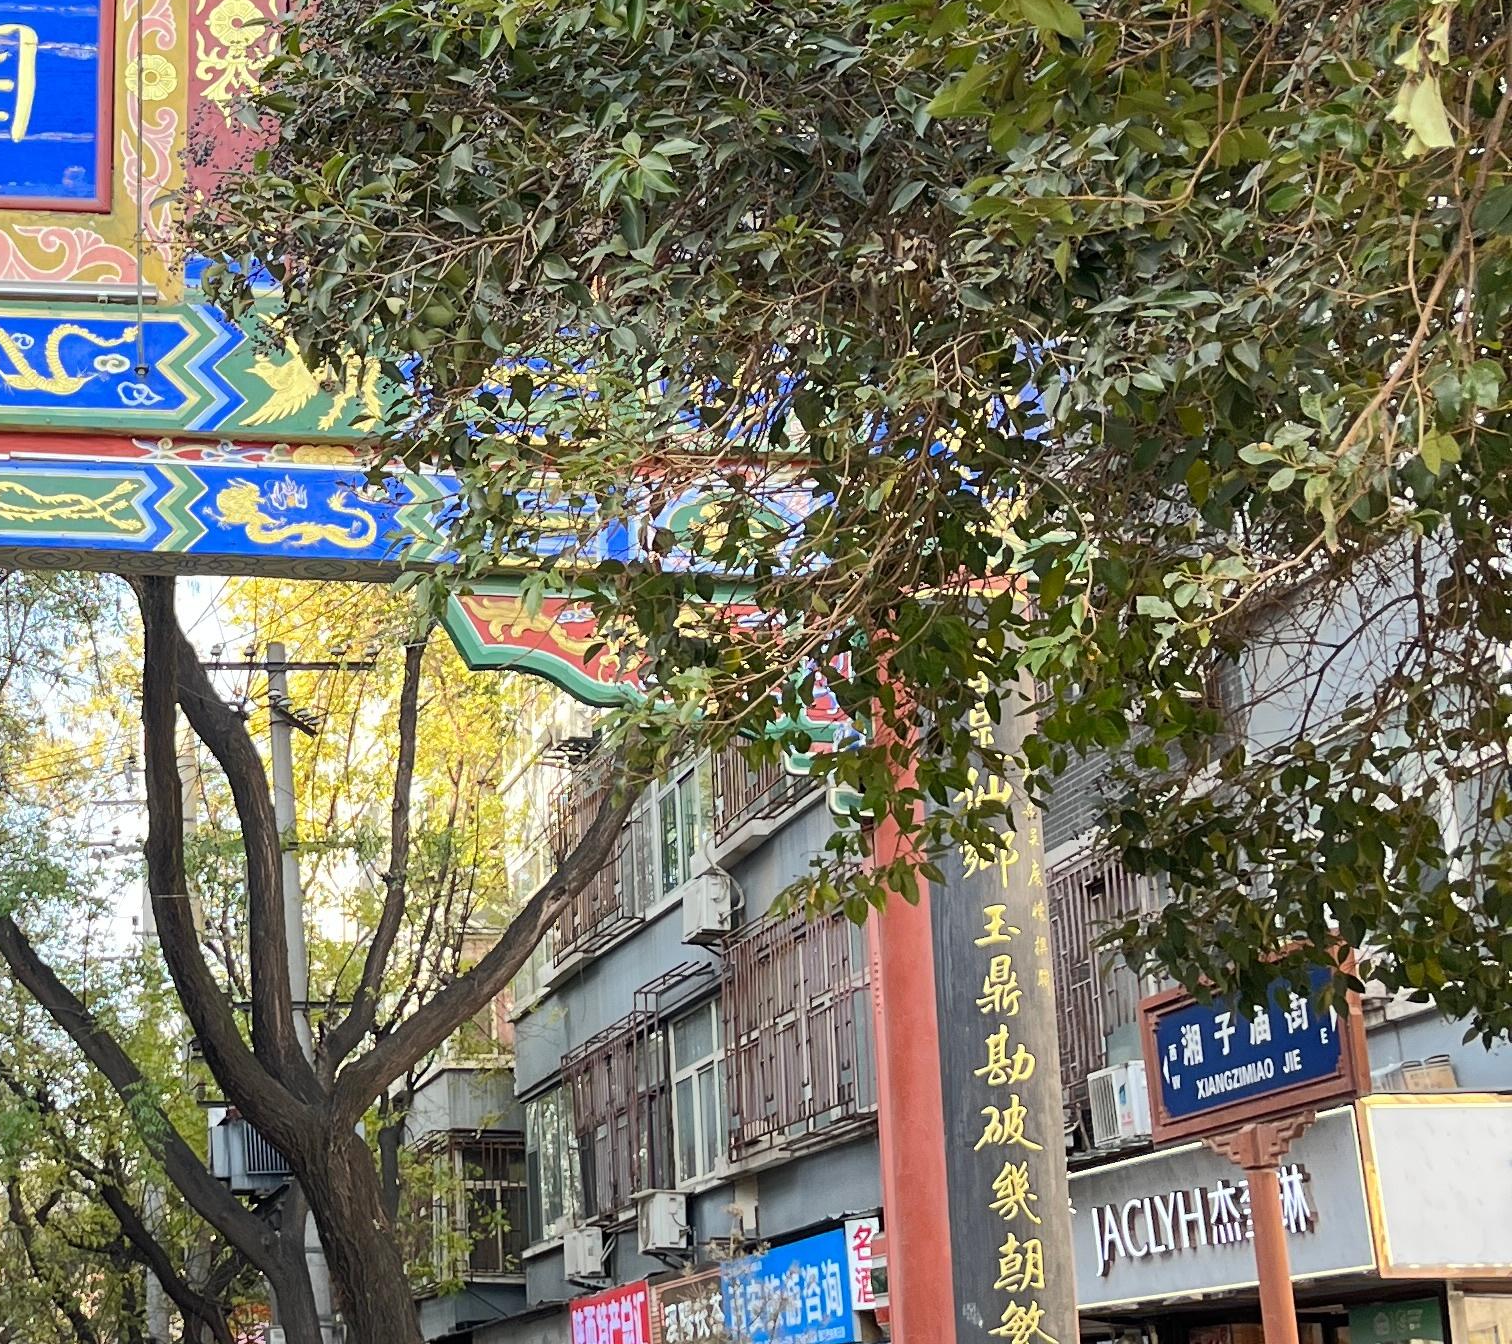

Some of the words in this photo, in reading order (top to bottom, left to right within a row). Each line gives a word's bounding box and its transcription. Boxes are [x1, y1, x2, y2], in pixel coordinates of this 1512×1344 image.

[1180, 991, 1309, 1066] 湘子庙街
[1319, 1027, 1329, 1044] E
[1171, 1074, 1181, 1090] W
[1195, 1057, 1275, 1100] XIANGZIMIAO
[1282, 1048, 1303, 1074] JIE
